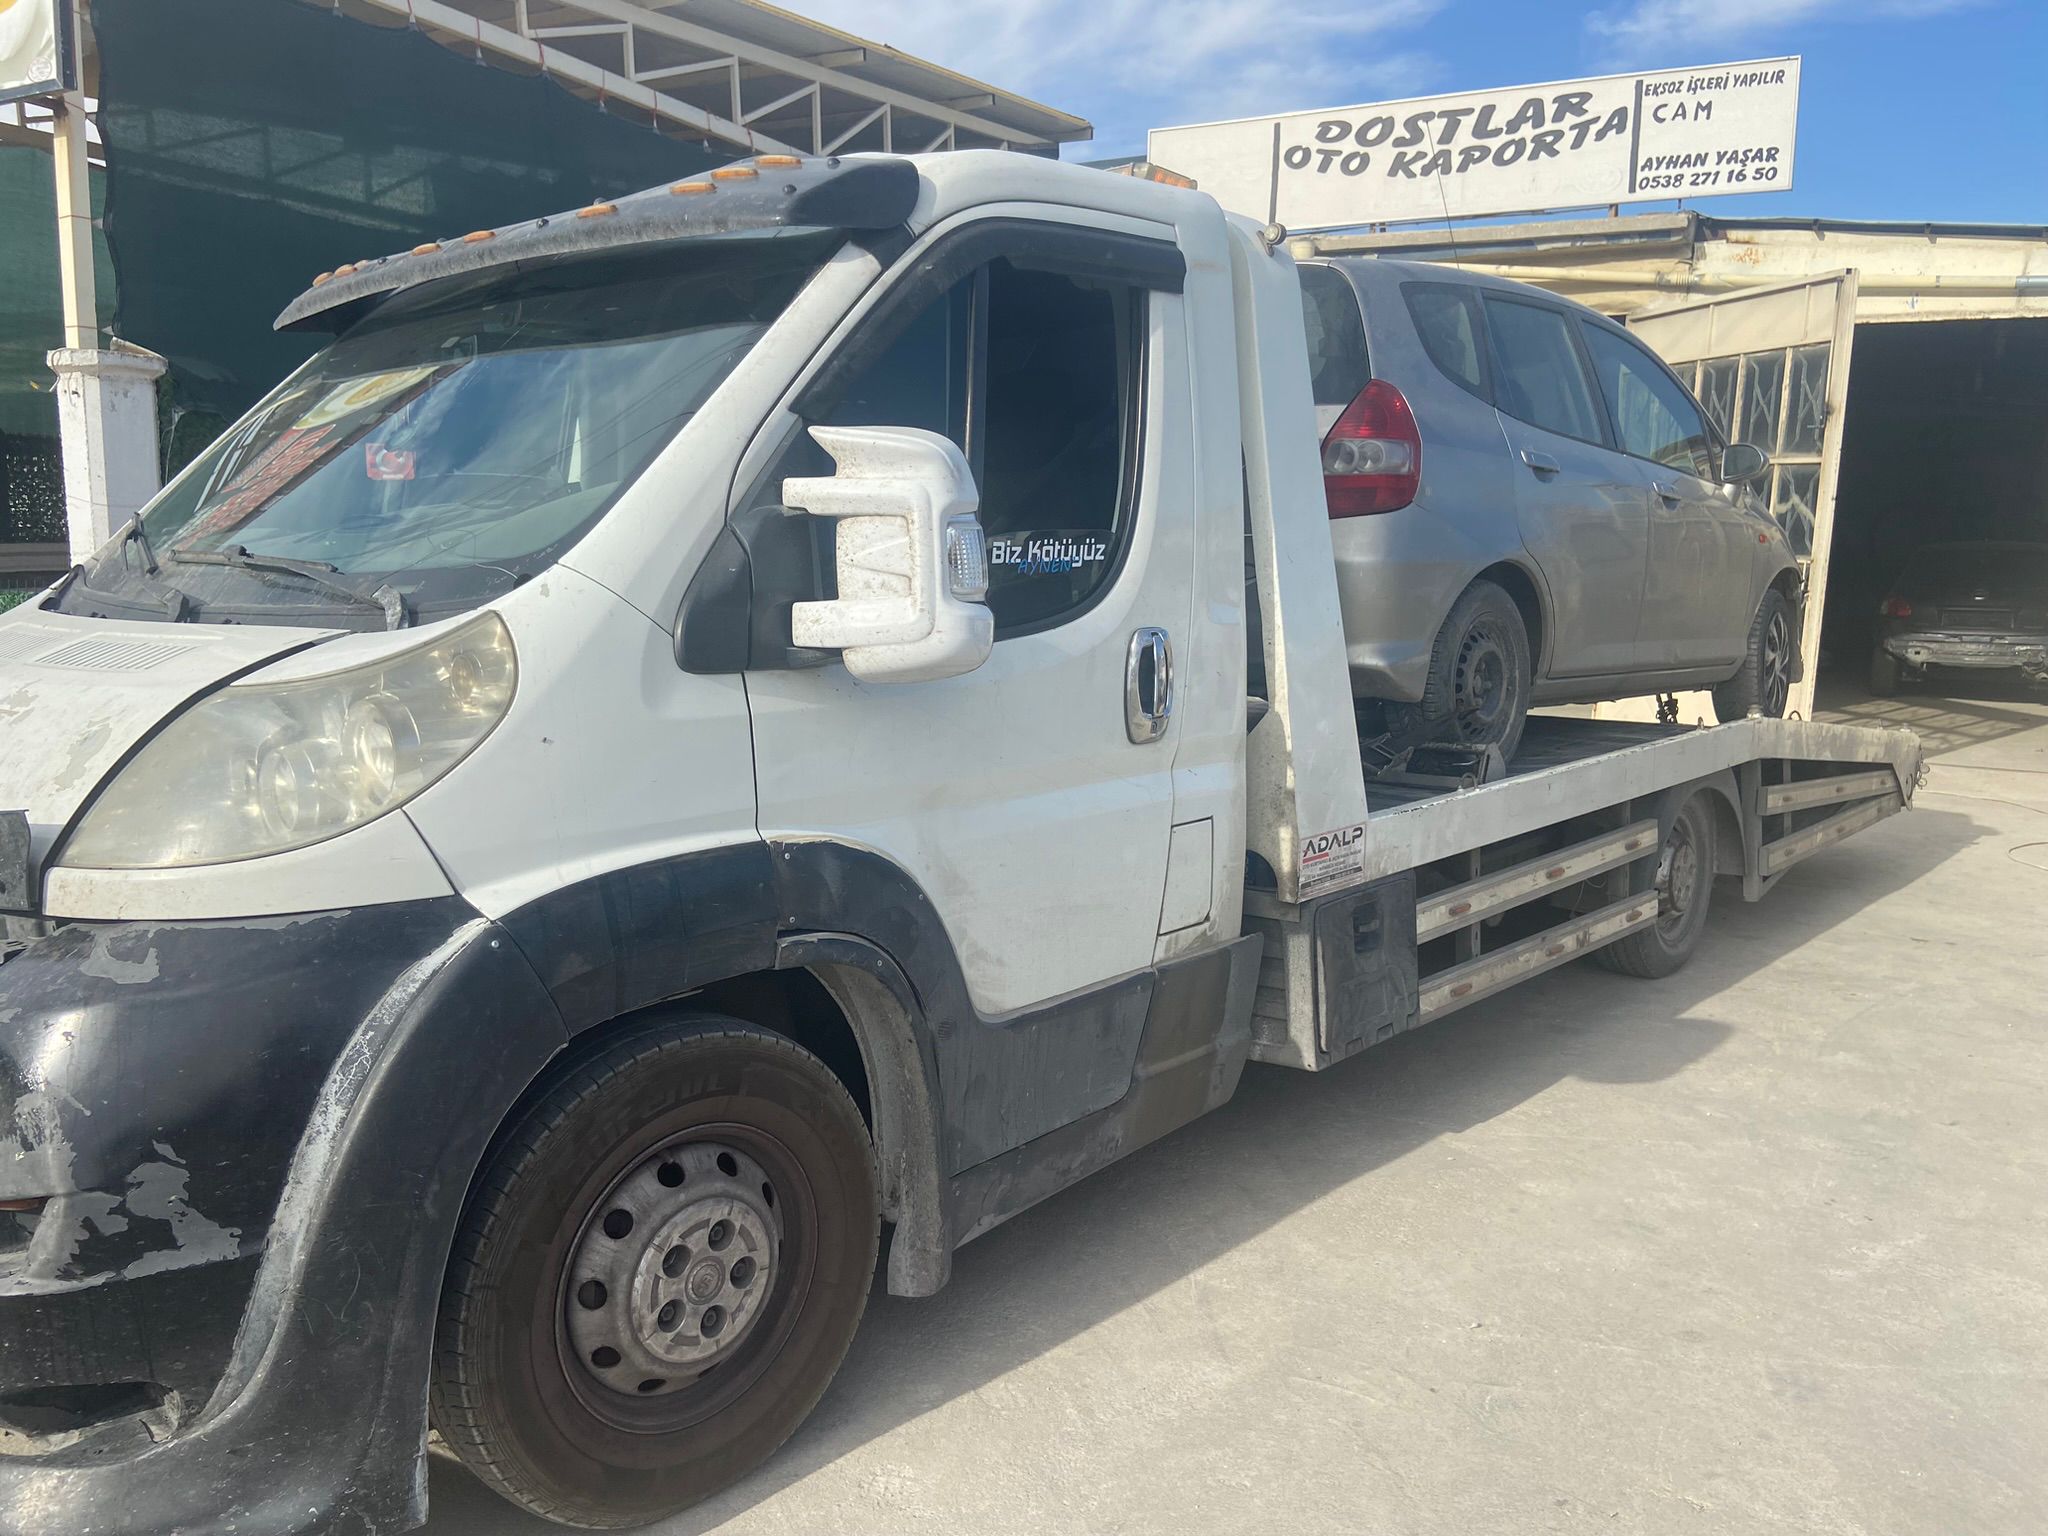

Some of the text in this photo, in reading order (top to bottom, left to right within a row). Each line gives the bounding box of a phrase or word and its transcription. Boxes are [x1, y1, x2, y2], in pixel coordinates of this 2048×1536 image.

[1644, 69, 1785, 97] EKSOZ İŞLERİ YAPILIR
[1315, 92, 1594, 148] DOSTLAR
[1284, 106, 1629, 179] OTO KAPORTA
[1640, 147, 1780, 172] AYHAN YAŞAR
[1638, 167, 1778, 190] 0538 271 16 50
[991, 538, 1106, 568] Biz Kötüyüz
[1302, 826, 1363, 858] ADALP
